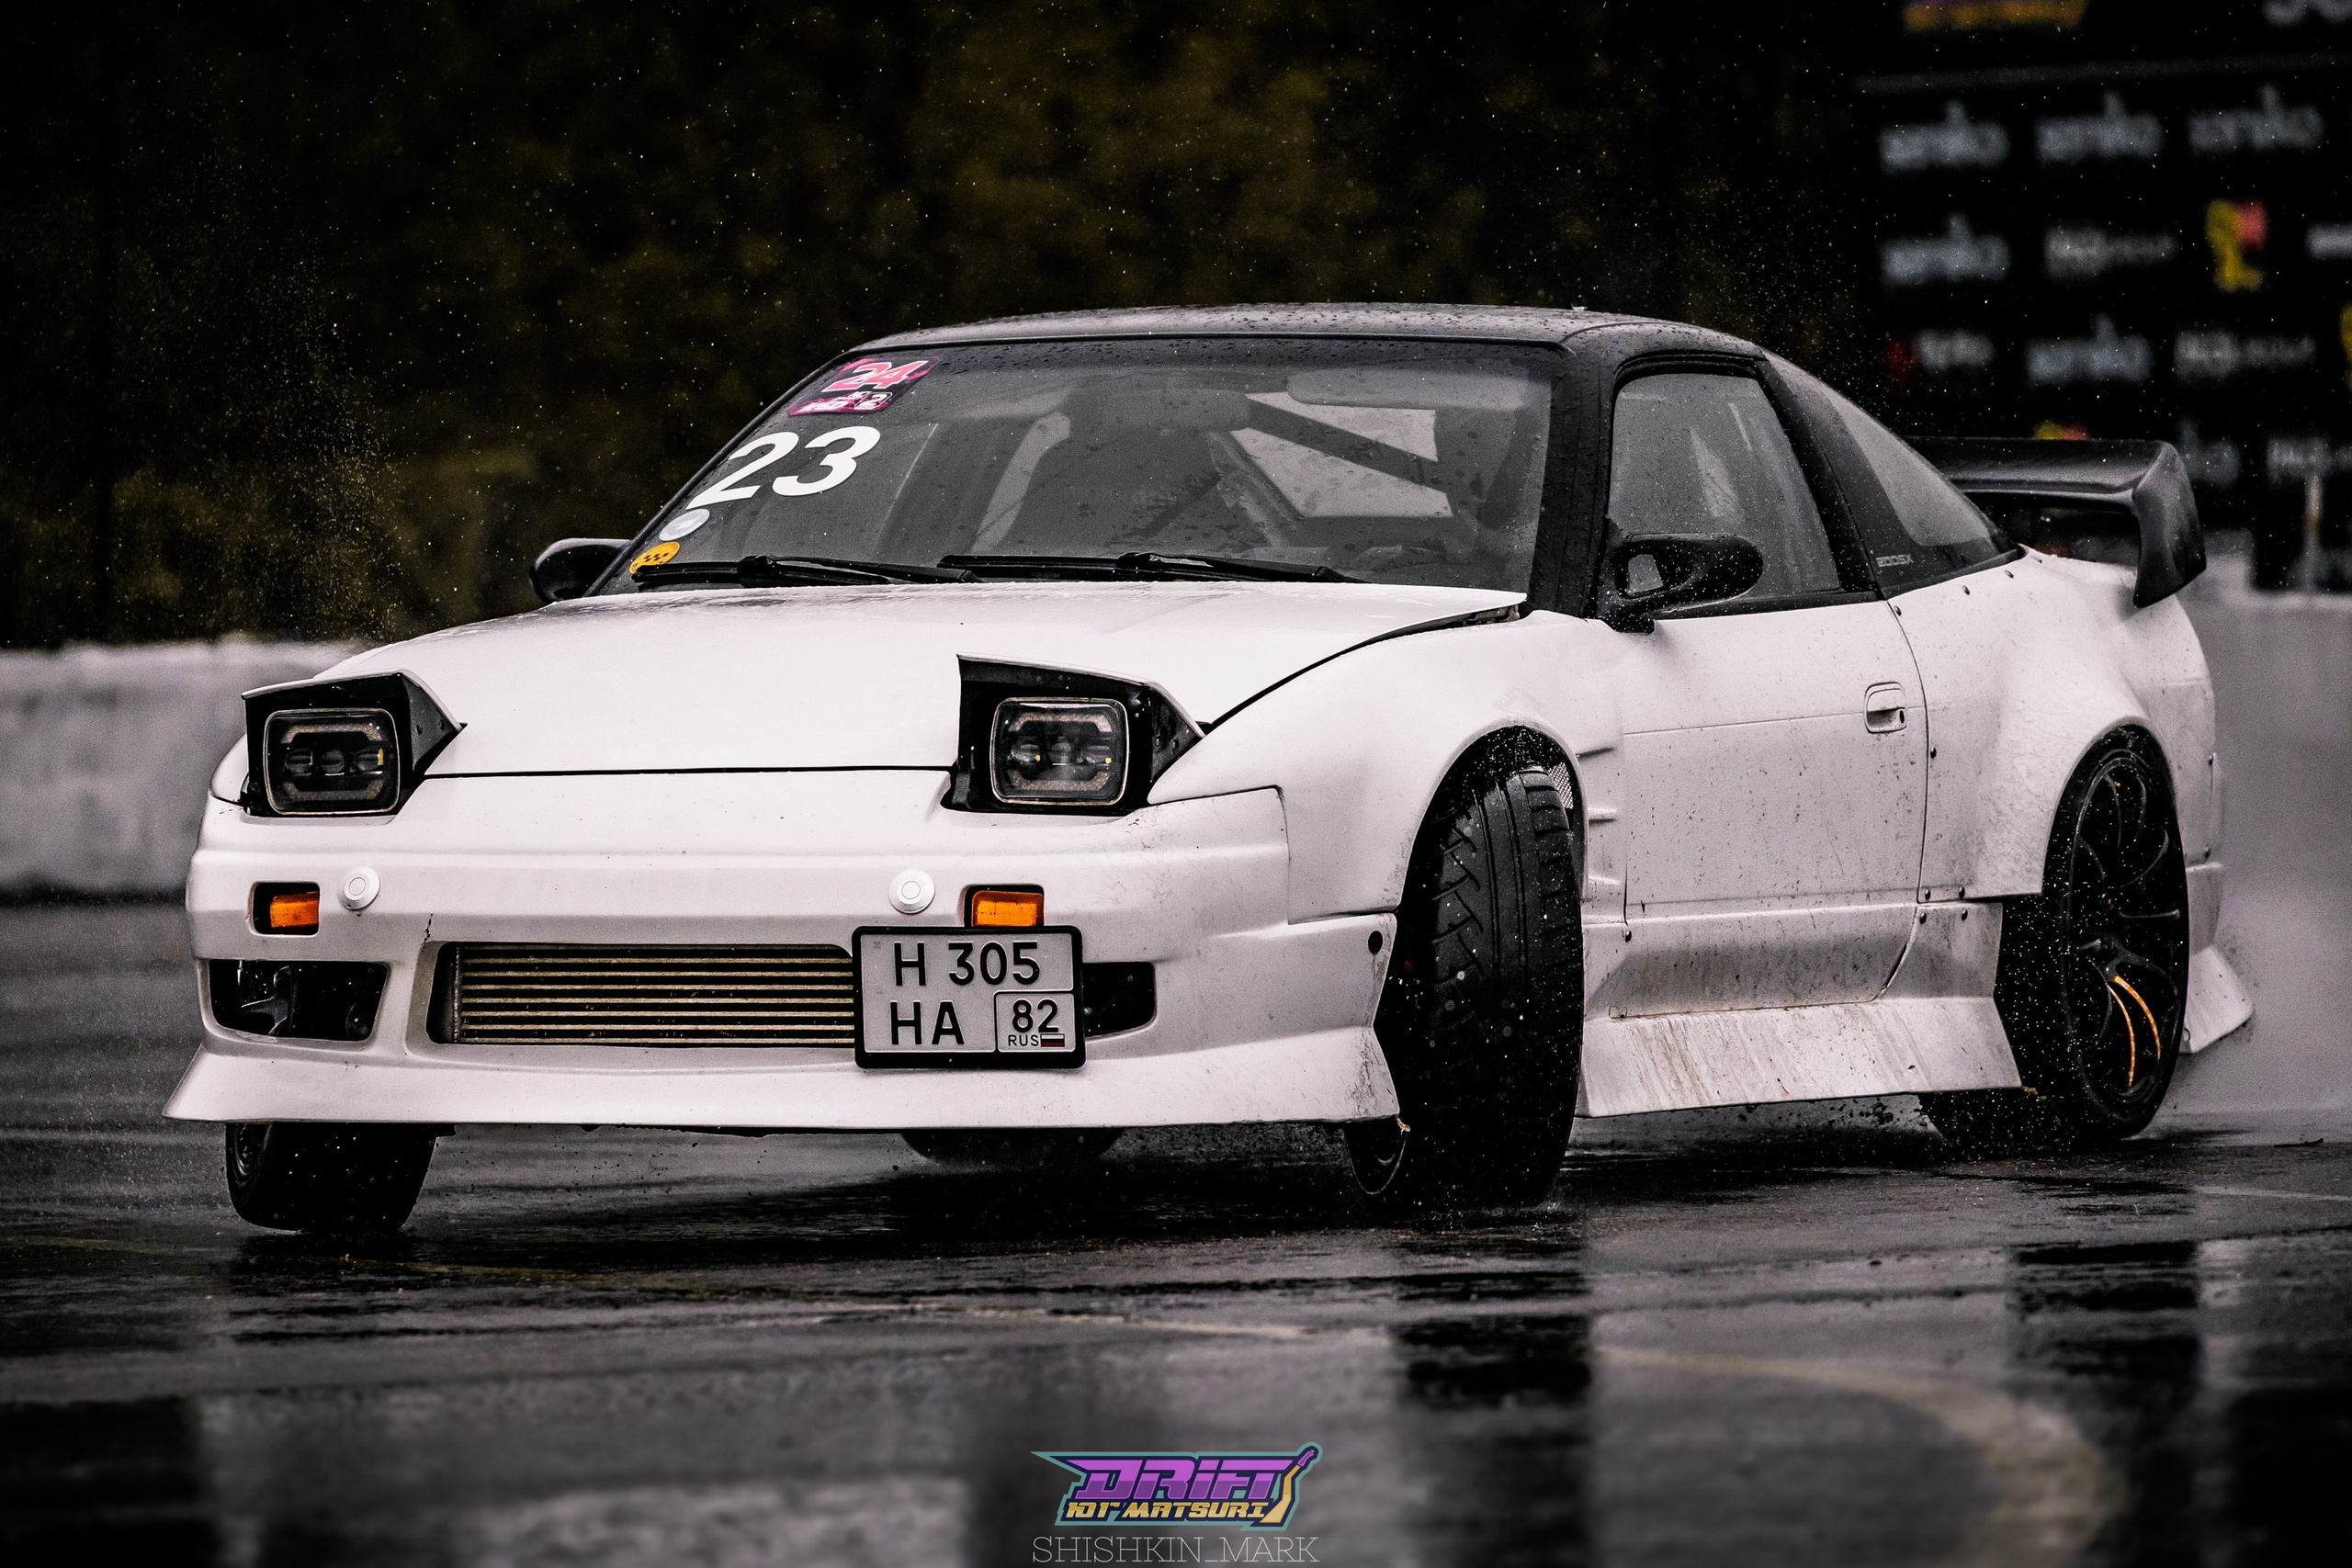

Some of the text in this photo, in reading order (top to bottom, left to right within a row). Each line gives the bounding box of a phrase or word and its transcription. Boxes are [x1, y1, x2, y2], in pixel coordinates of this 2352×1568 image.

[821, 361, 929, 392] 24
[685, 425, 880, 510] 23
[894, 942, 1040, 986] H 305
[890, 1000, 965, 1045] HA
[1012, 999, 1059, 1033] 82
[1007, 1034, 1039, 1047] RUS
